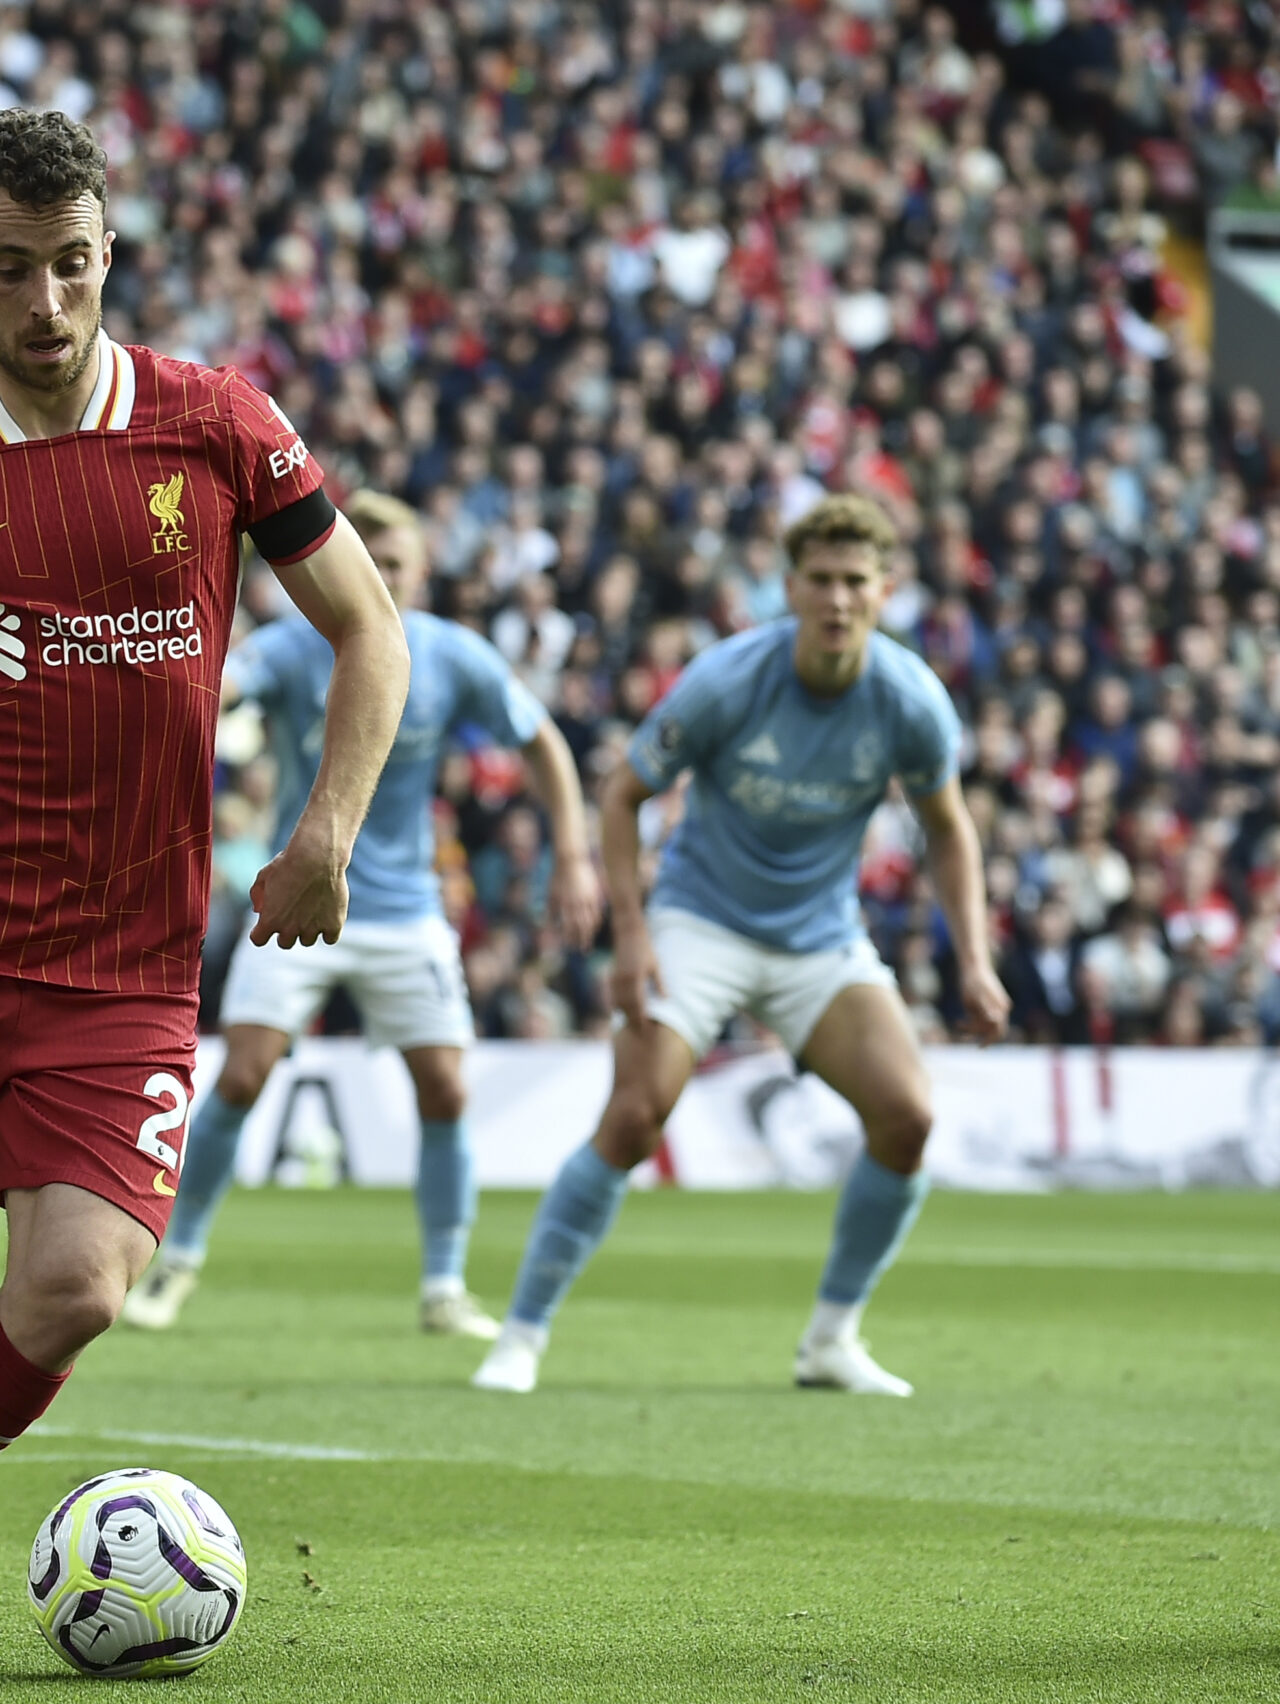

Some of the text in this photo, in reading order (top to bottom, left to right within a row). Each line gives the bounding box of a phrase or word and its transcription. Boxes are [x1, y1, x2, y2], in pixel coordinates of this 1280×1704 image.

[268, 439, 310, 479] Exp
[40, 600, 195, 638] standard
[42, 627, 203, 667] chartered
[135, 1072, 191, 1171] 2
